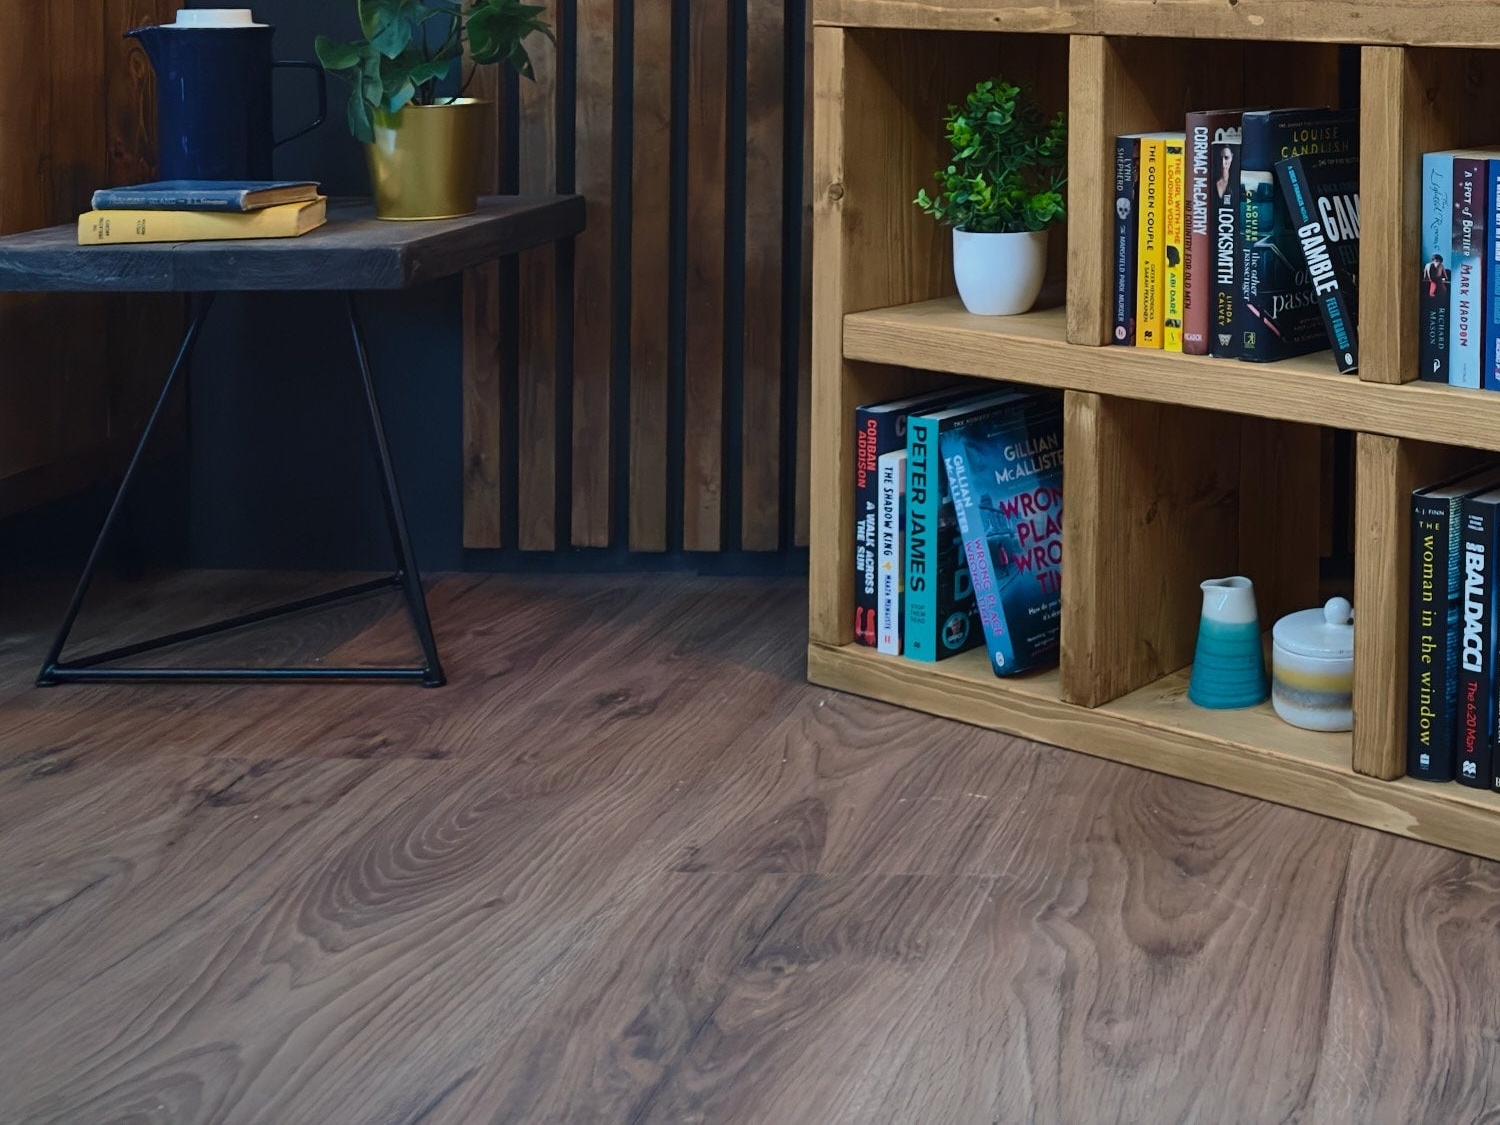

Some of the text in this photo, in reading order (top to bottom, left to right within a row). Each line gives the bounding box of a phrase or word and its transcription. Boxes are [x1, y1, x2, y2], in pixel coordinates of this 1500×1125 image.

[1293, 127, 1340, 143] LOUISE
[1116, 147, 1124, 191] SHEPHERD
[1124, 158, 1132, 181] LYNN
[1148, 166, 1156, 209] GOLDEN
[1194, 127, 1208, 235] CORMAC McCARTHY
[1146, 211, 1155, 251] COUPLE
[1217, 195, 1234, 285] THE LOCKSMITH
[1244, 191, 1252, 241] CANDLISH
[1242, 249, 1250, 301] passenger
[1251, 253, 1260, 297] the other
[1298, 223, 1338, 295] GAMBLE
[1218, 291, 1226, 327] CALVEY
[1326, 297, 1350, 349] FELIX FRANCIS
[1438, 307, 1446, 350] RICHARD
[1460, 263, 1472, 347] MARK HADDON
[858, 430, 866, 489] ADDISON
[866, 419, 877, 471] CORBAN
[1004, 432, 1058, 461] GILLIAN
[944, 458, 969, 533] McALLISTER
[954, 455, 974, 507] GILLIAN
[883, 467, 894, 556] THE SHADOW KING
[910, 426, 927, 591] PETER JAMES
[1418, 521, 1440, 531] THE
[856, 519, 866, 571] THE SUN
[864, 501, 876, 595] A WALK ACROSS
[975, 538, 1003, 635] WRONG PLACE
[1462, 550, 1484, 673] BALDACCI
[1420, 535, 1437, 746] woman in the window
[1466, 681, 1477, 753] The 6:20 Man
